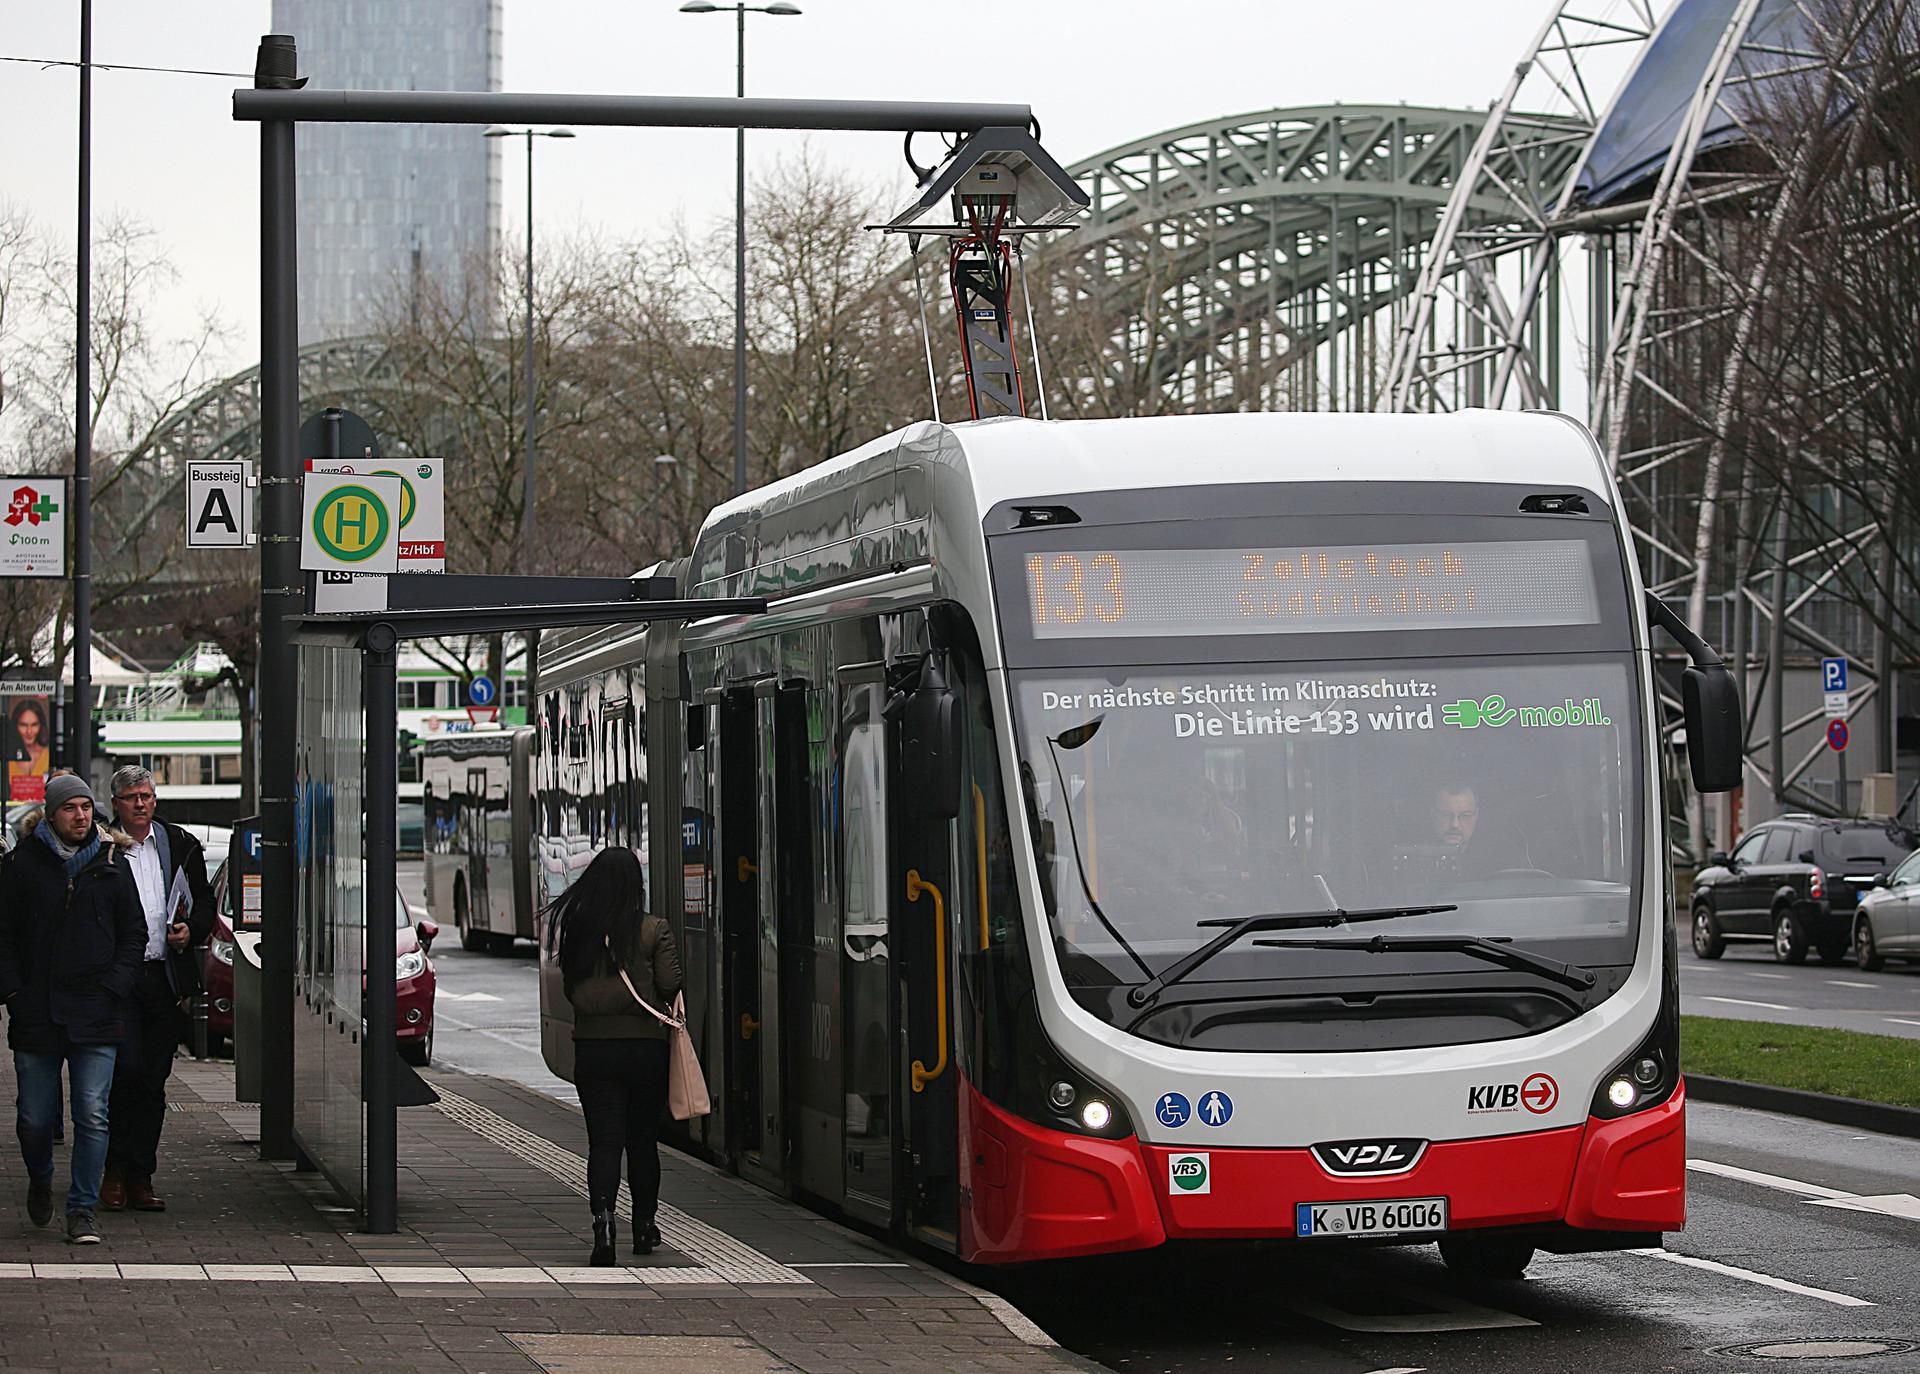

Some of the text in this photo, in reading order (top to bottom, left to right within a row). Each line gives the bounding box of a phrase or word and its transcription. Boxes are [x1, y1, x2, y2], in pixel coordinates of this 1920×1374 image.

[192, 470, 240, 483] Bussteig
[195, 488, 238, 533] A
[335, 502, 367, 545] H
[21, 537, 38, 545] 100
[399, 545, 435, 556] tz/Hbf
[1242, 551, 1464, 581] Zollstock
[1028, 554, 1124, 624] 133
[1236, 586, 1476, 616] Südfriedhof
[0, 683, 54, 692] Am Alten Ufer
[1826, 662, 1840, 689] P
[1042, 678, 1438, 710] Der nächste Schritt im Klimaschutz:
[1174, 711, 1223, 738] Die
[1232, 708, 1301, 735] Linie
[1310, 709, 1360, 735] 133
[1368, 704, 1434, 731] wird
[1519, 698, 1612, 728] mobil.
[1467, 1084, 1519, 1109] KVB
[1330, 1144, 1406, 1165] VDL
[1171, 1163, 1199, 1175] VRS
[1302, 1203, 1442, 1232] D K VB 6006
